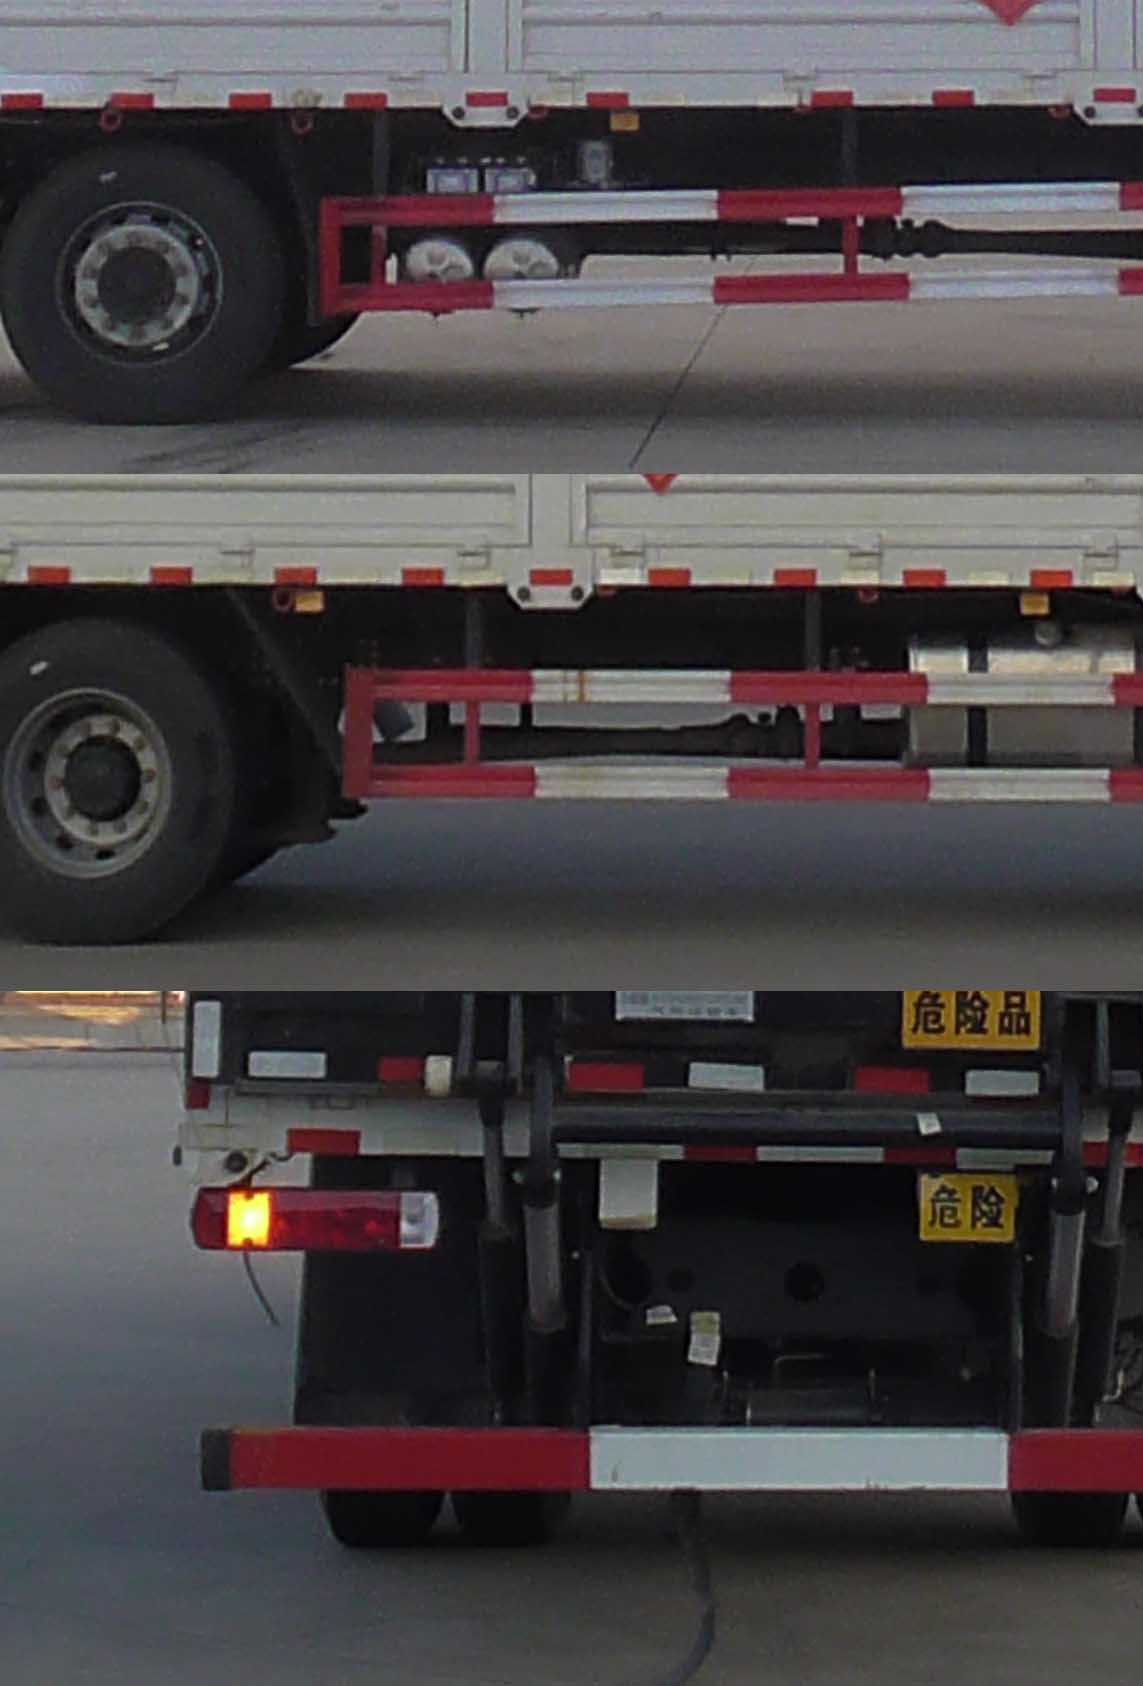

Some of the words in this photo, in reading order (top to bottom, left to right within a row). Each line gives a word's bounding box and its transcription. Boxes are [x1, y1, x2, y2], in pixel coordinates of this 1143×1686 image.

[911, 991, 1031, 1036] 危险品
[928, 1184, 1005, 1230] 危险
